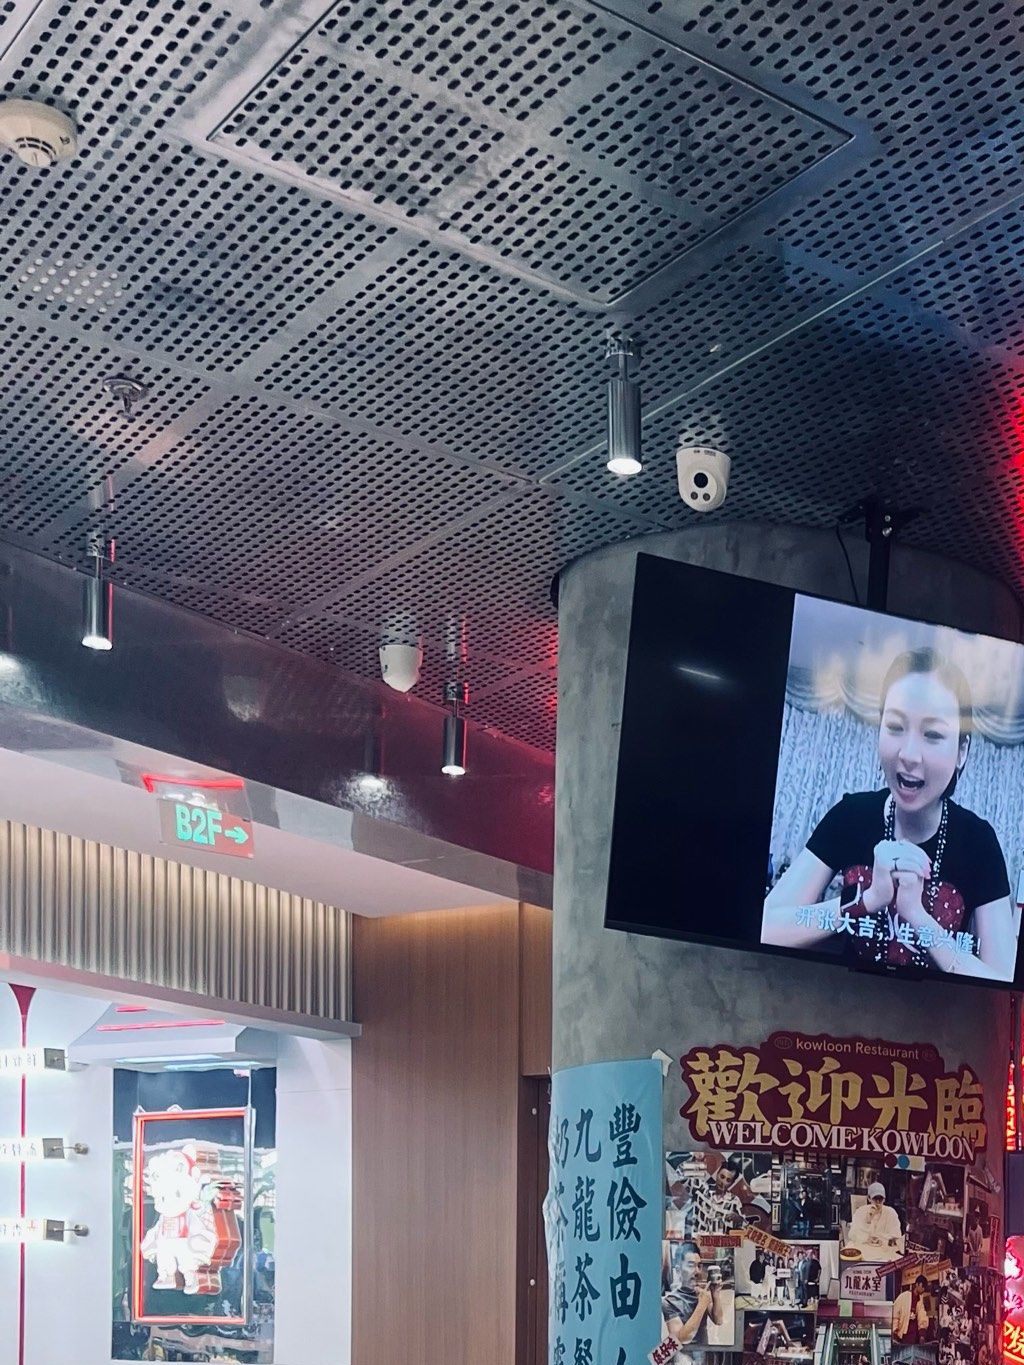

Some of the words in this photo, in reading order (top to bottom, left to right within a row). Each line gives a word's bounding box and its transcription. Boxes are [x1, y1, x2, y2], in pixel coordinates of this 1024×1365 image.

[174, 803, 223, 847] B2F
[796, 1037, 851, 1053] kowloon
[855, 1042, 919, 1060] Restaurant
[686, 1050, 986, 1149] 歡迎光臨
[708, 1120, 860, 1151] WELCOME
[859, 1126, 976, 1162] KOWLOON
[844, 1275, 882, 1292] 九龍冰室
